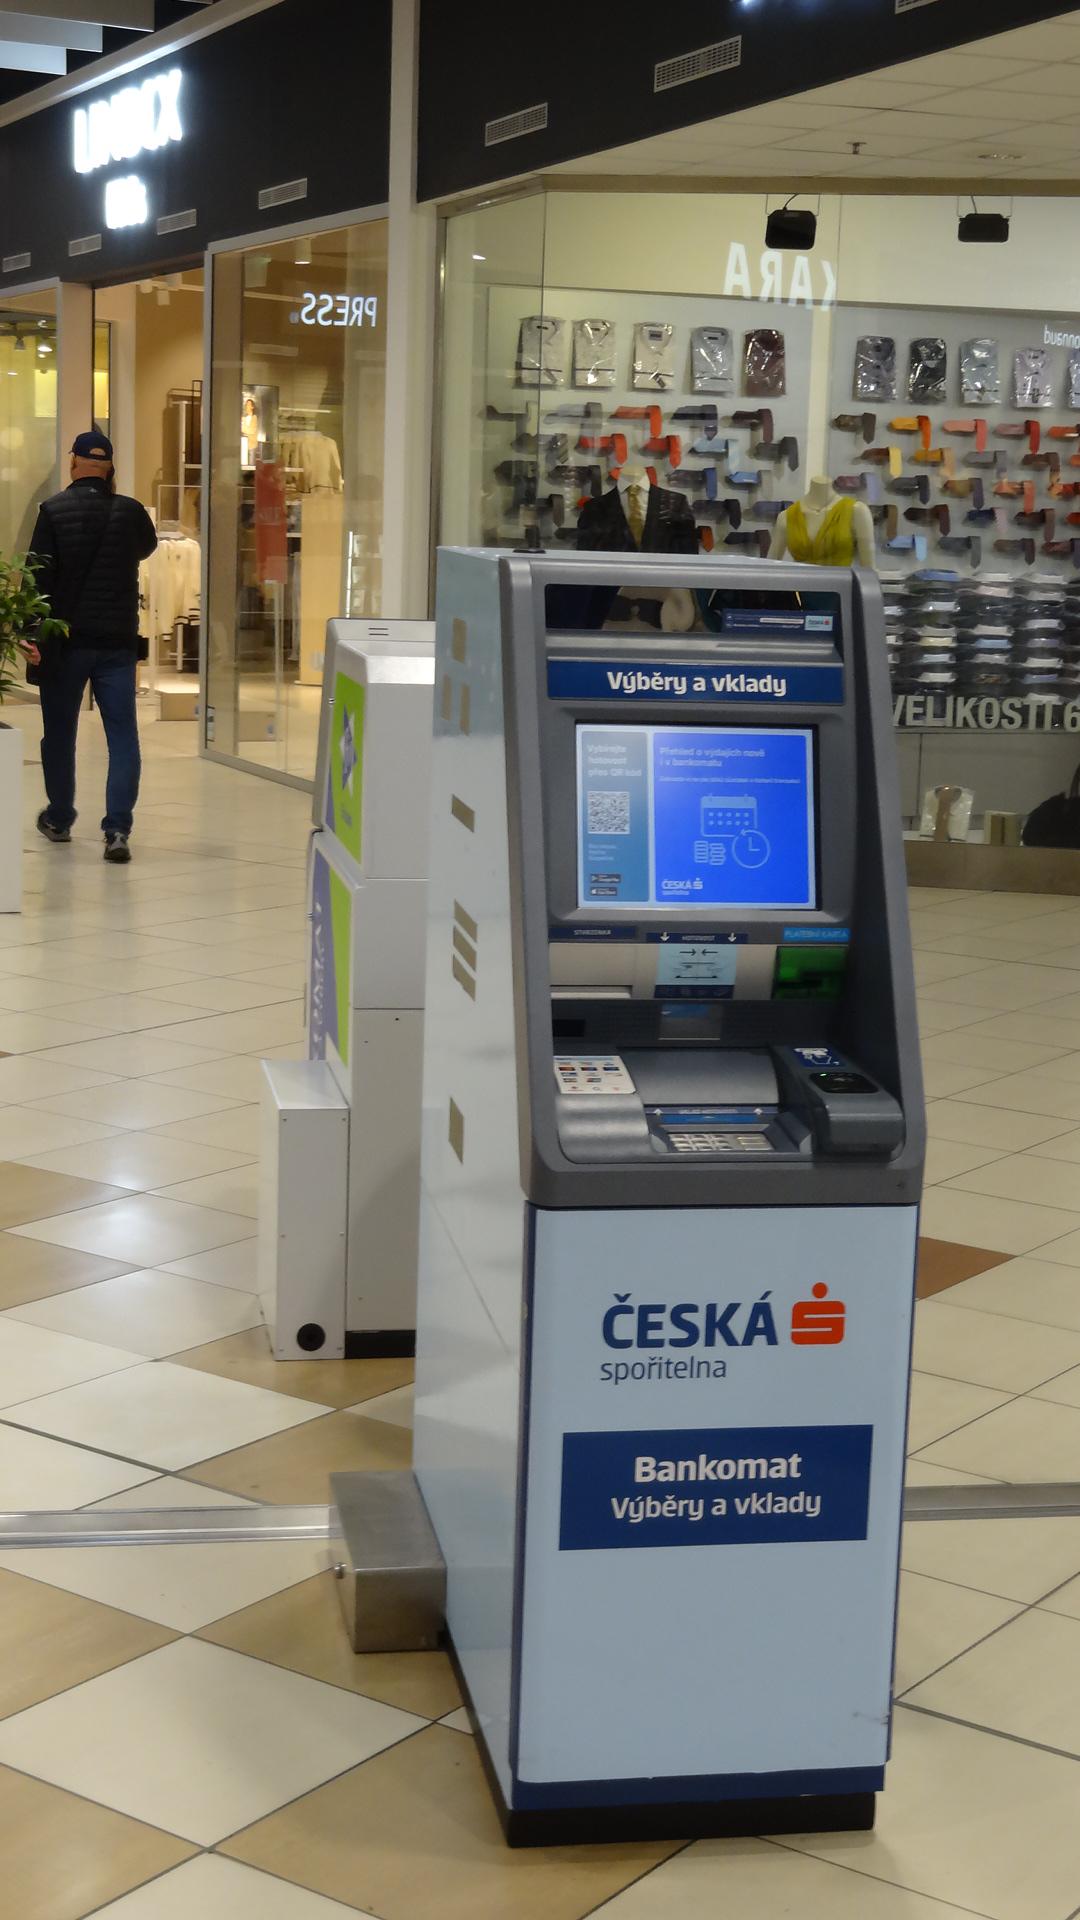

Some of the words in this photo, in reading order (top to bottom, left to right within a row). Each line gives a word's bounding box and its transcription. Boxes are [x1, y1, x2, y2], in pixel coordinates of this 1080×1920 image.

[607, 671, 687, 695] Výběry
[693, 676, 706, 692] a
[712, 673, 787, 696] vklady
[602, 1290, 779, 1350] ČESKÁ
[600, 1356, 727, 1385] spořitelna
[634, 1453, 802, 1483] Bankomat
[611, 1494, 704, 1523] Výběry
[711, 1497, 727, 1516] a
[734, 1491, 822, 1517] vklady
